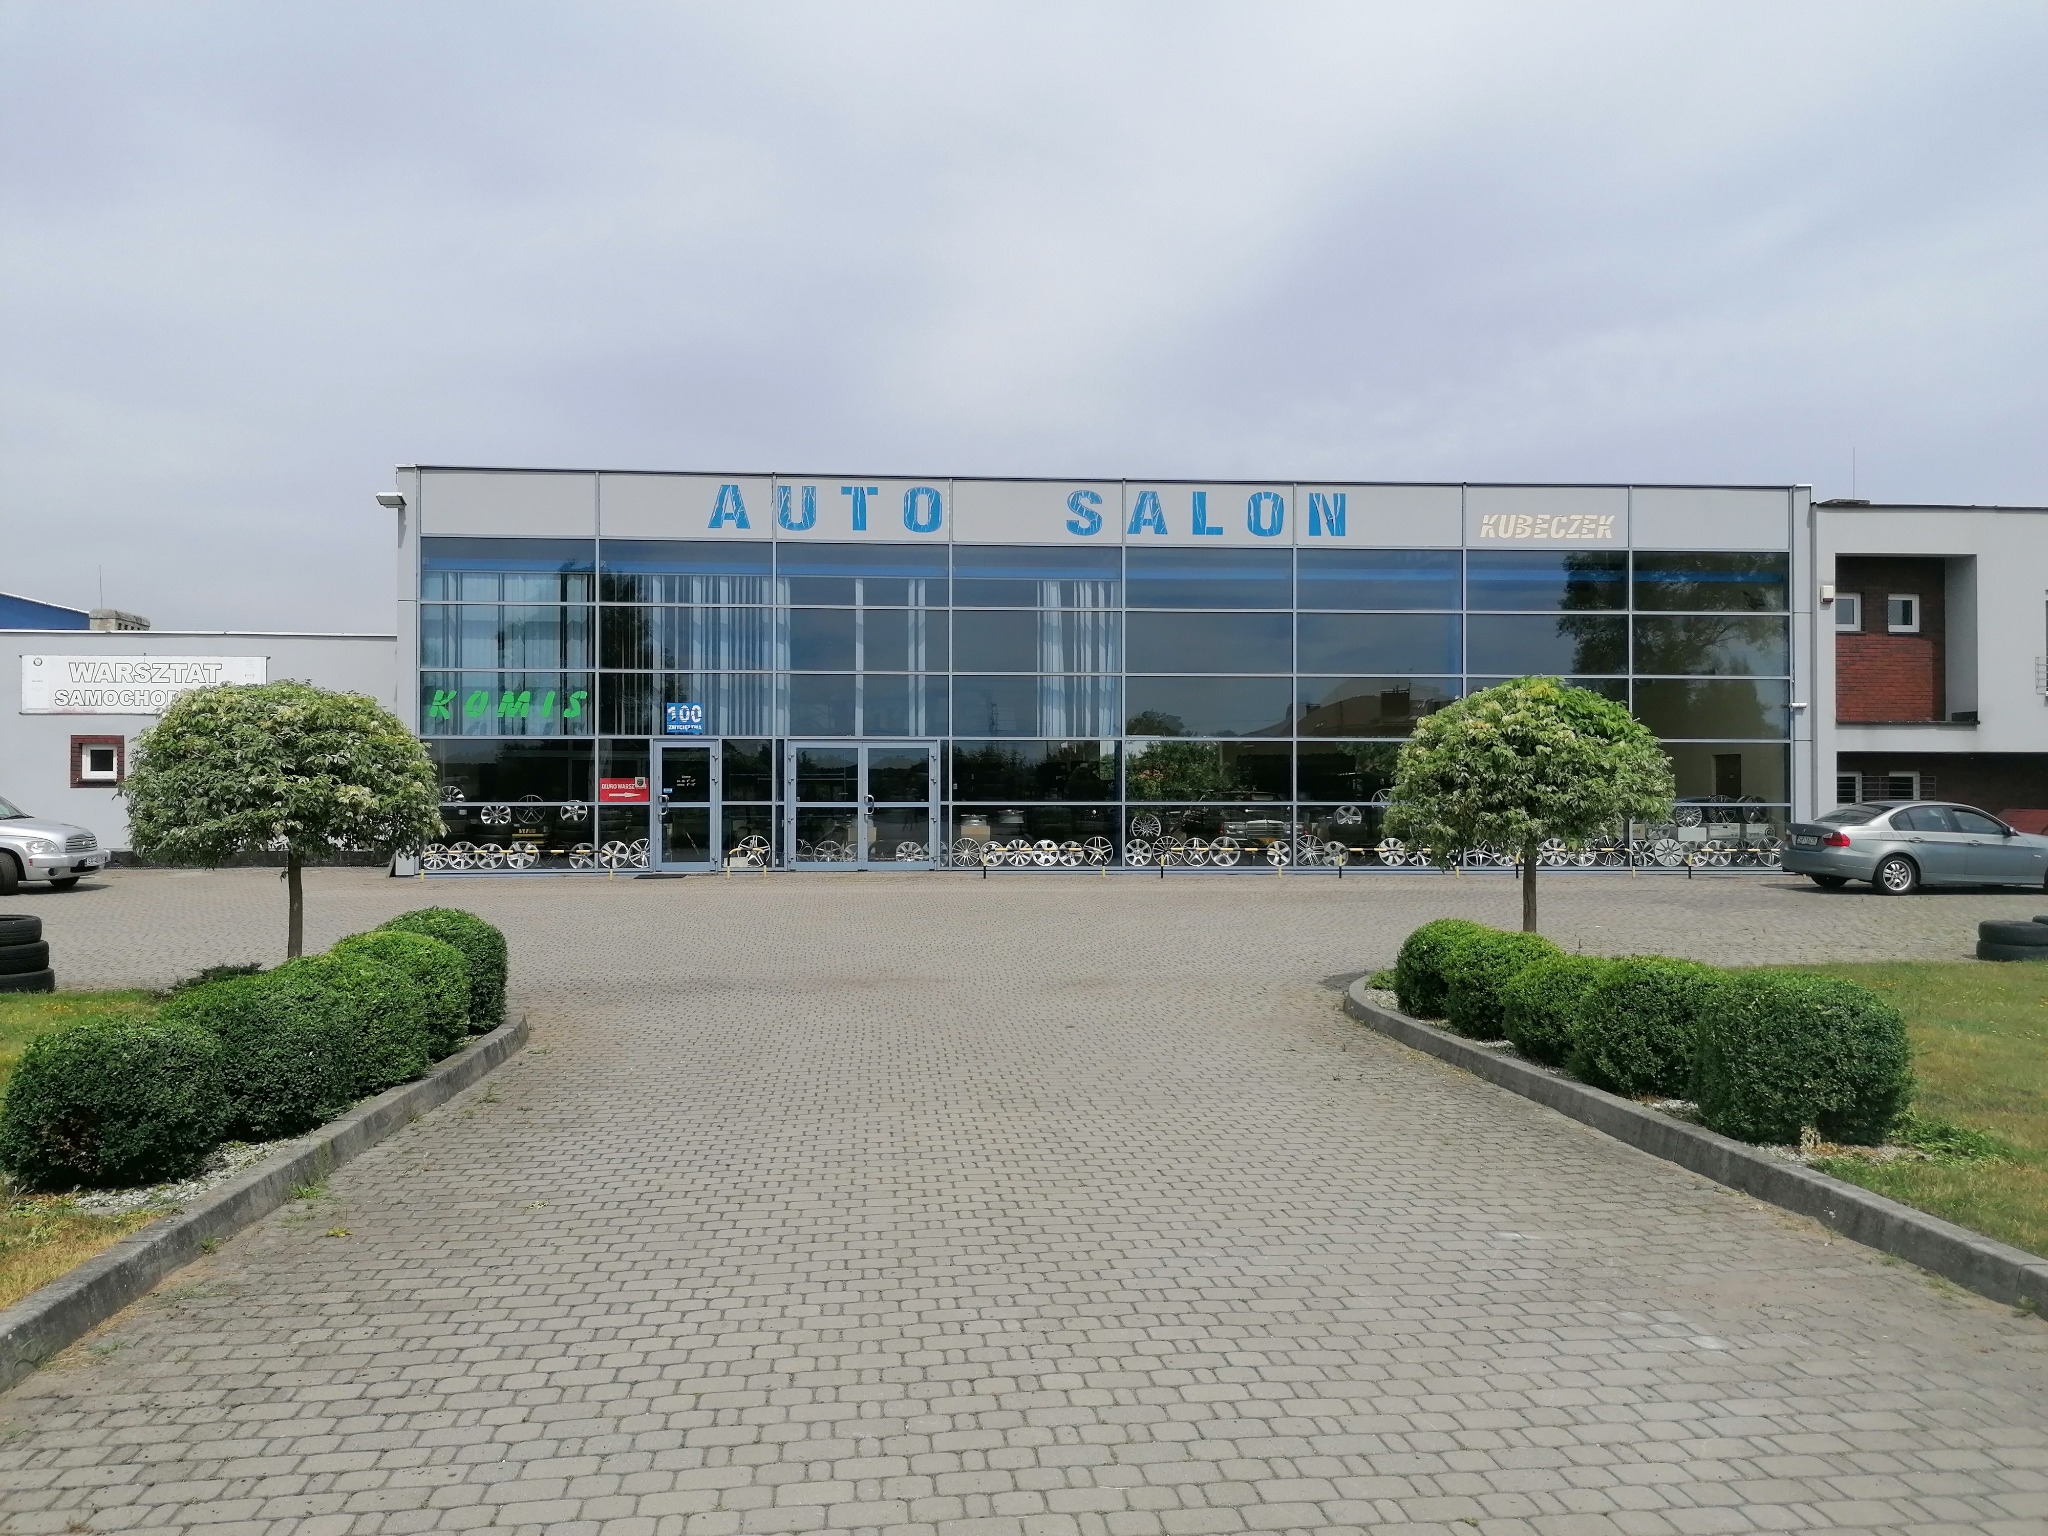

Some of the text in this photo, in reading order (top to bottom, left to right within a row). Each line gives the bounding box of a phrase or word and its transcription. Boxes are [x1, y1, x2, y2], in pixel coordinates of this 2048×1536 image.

[708, 484, 1346, 537] AUTO SALON
[1480, 514, 1616, 538] KUBECZEK
[68, 662, 222, 683] WARSZTAT
[55, 689, 180, 706] SAMOCHOD
[429, 690, 588, 719] KOMIS
[667, 704, 702, 723] 100
